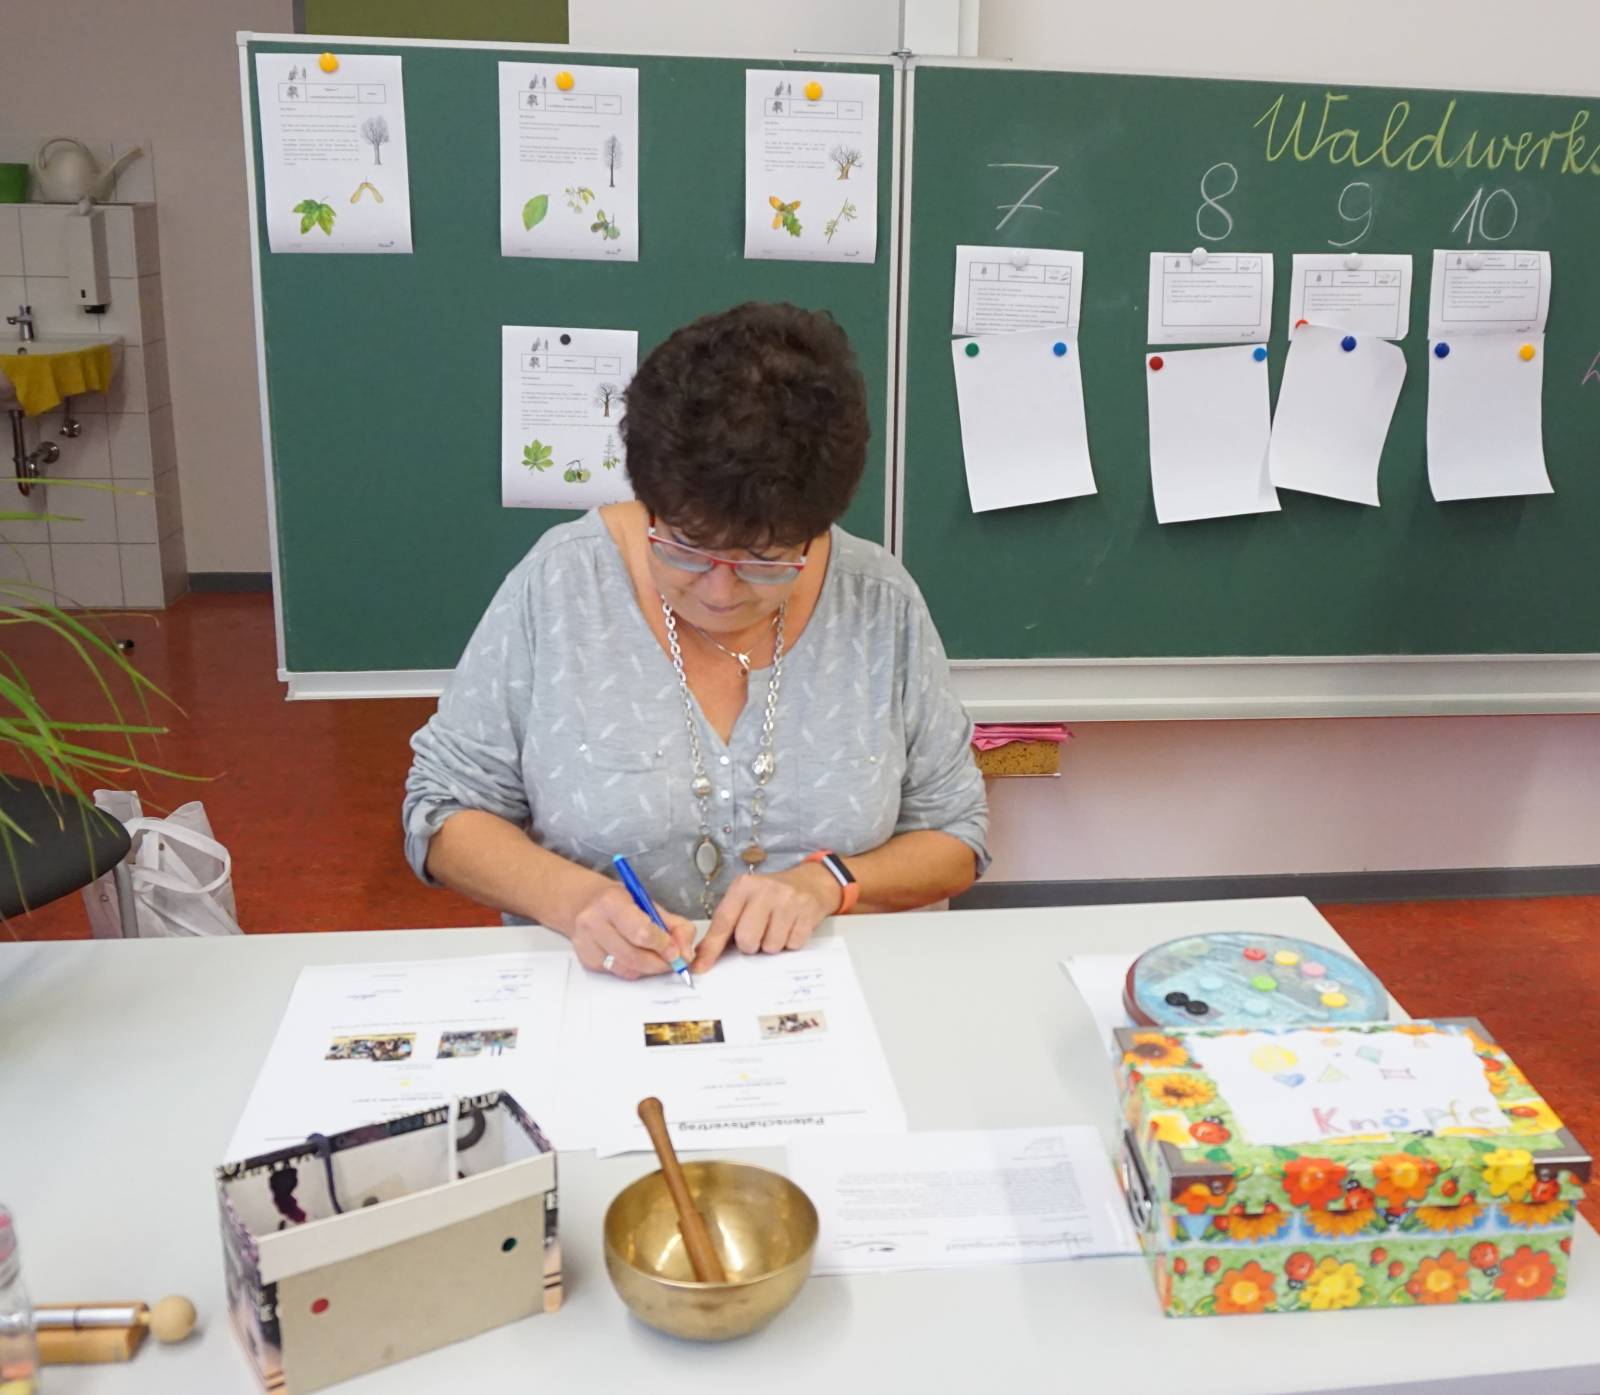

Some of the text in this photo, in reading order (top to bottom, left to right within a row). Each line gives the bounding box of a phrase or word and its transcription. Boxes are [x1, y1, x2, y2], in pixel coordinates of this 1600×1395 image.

[986, 162, 1060, 231] 7
[1195, 162, 1239, 241] 8
[1327, 181, 1373, 247] 9
[1451, 187, 1518, 245] 10
[678, 1116, 825, 1132] Patenschaftsvertrag
